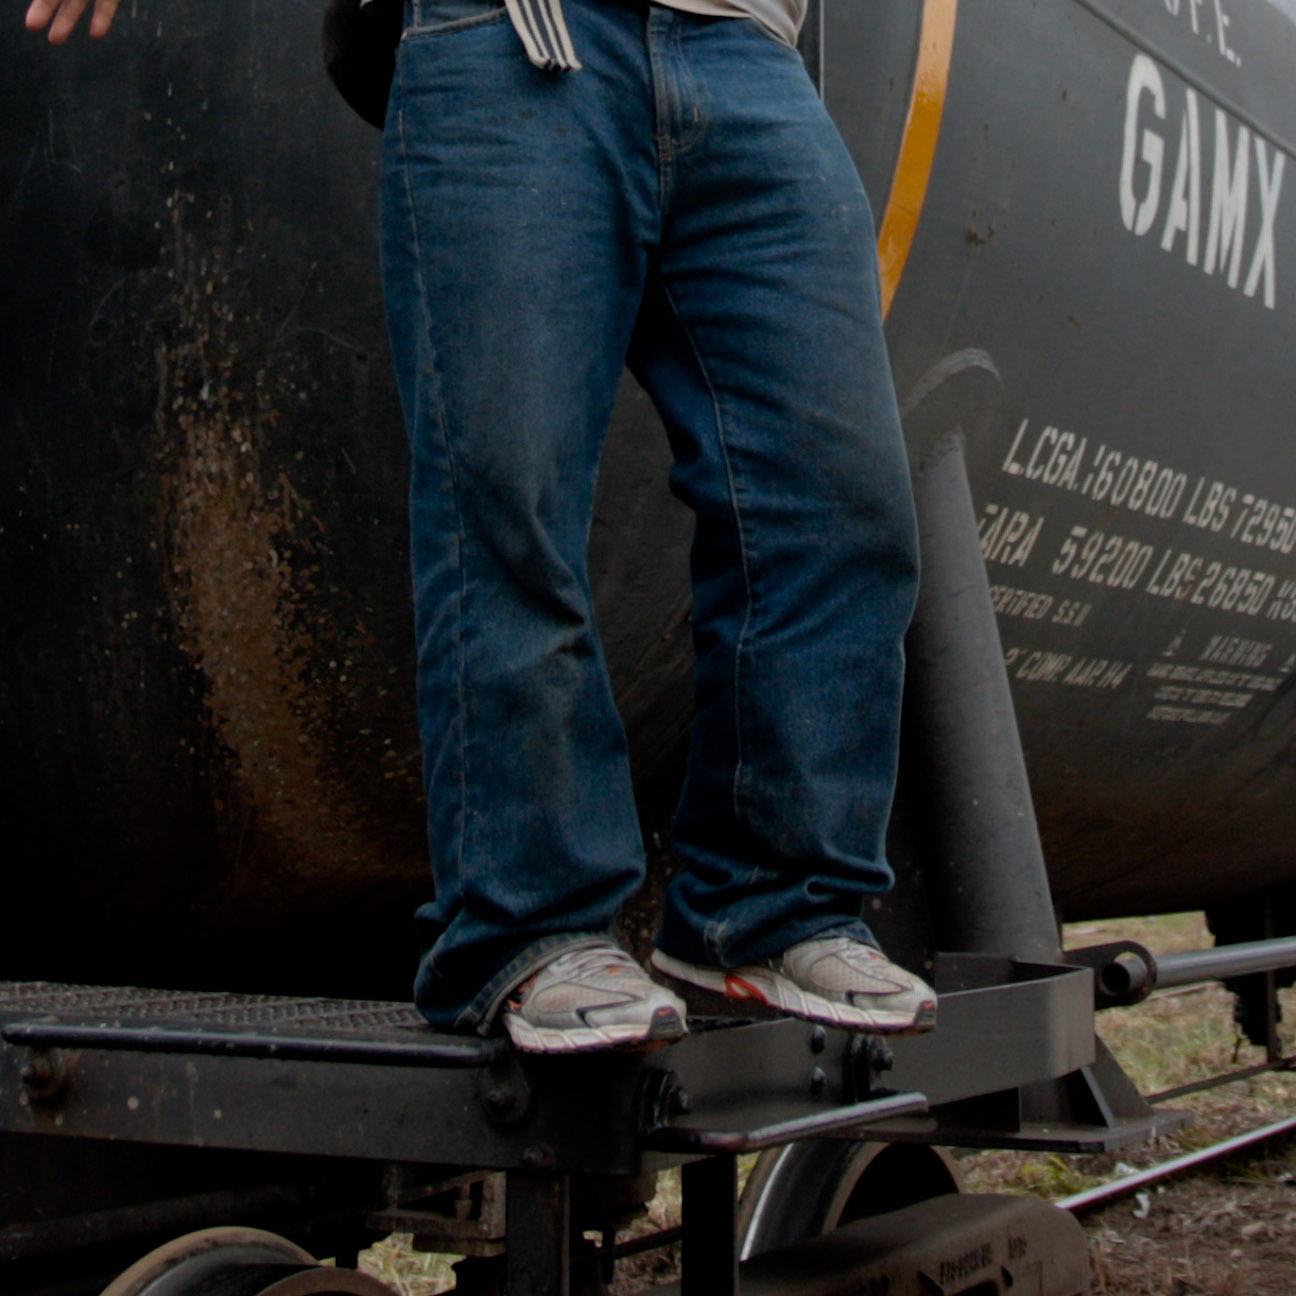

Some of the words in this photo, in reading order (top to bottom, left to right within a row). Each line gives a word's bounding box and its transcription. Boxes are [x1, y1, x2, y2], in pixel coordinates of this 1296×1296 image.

[1119, 53, 1285, 310] GAMX
[1182, 477, 1237, 533] LBS
[1052, 525, 1153, 589] 59200
[1190, 561, 1276, 617] 26850
